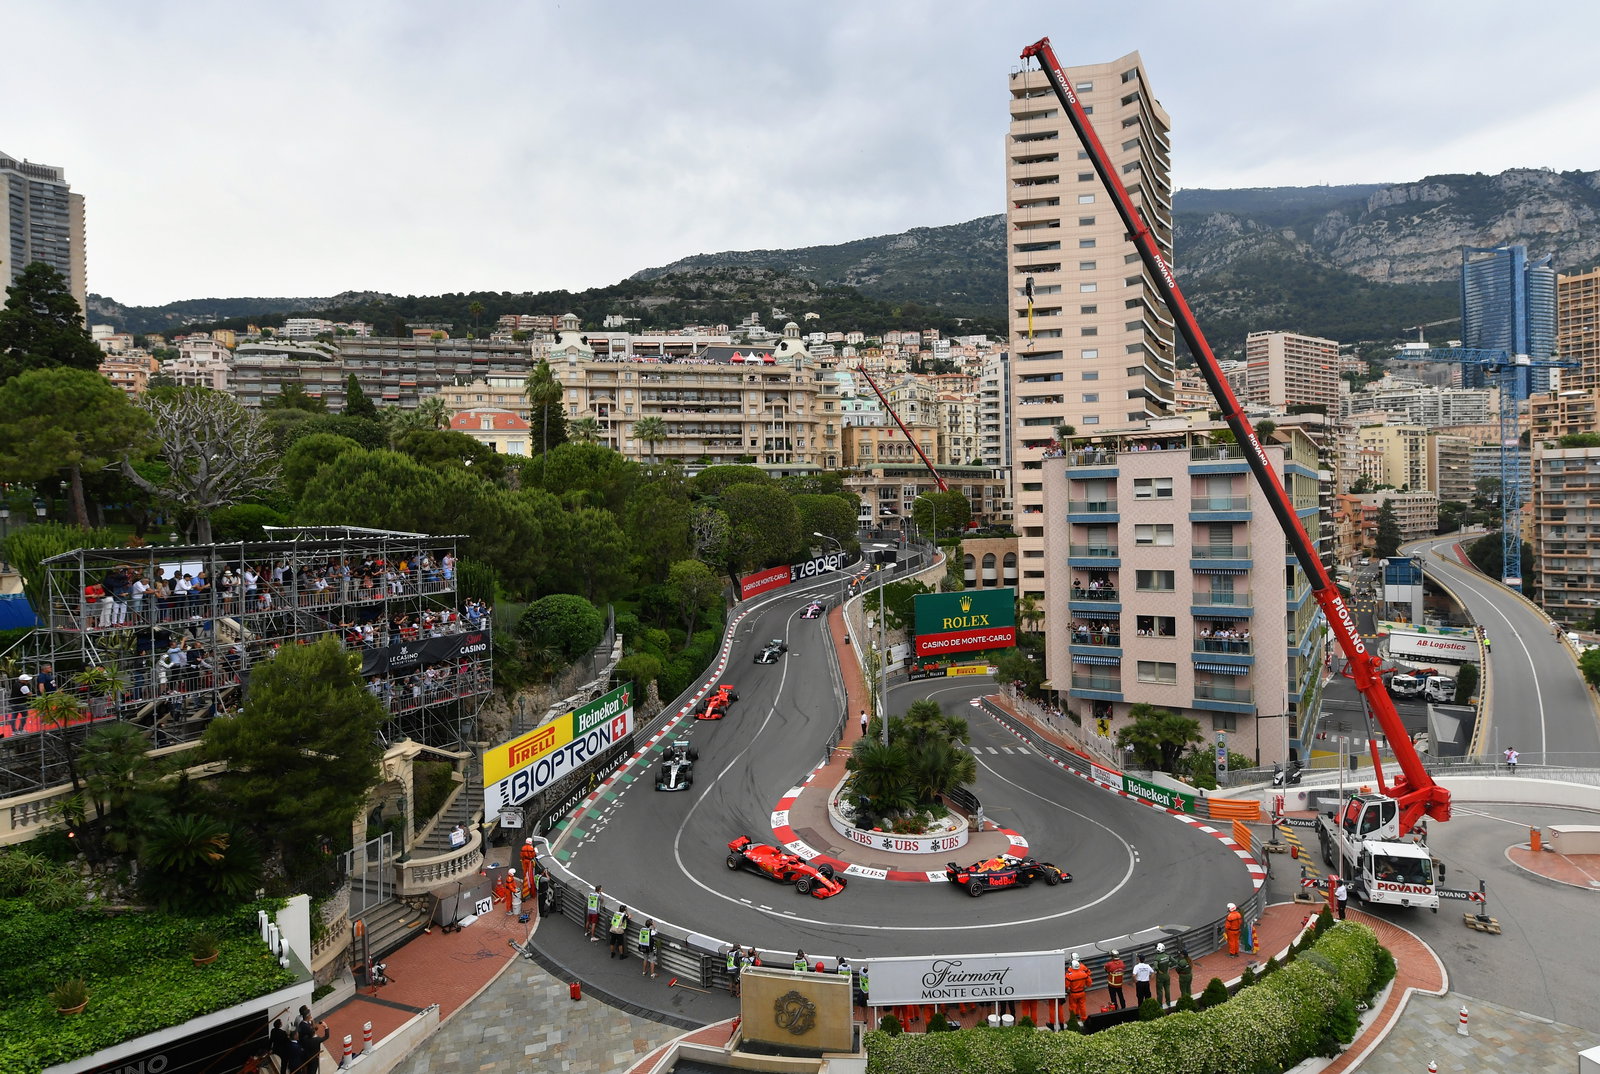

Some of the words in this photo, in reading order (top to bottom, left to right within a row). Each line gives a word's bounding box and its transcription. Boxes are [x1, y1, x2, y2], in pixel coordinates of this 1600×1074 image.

[1054, 68, 1076, 104] PIOVANO
[1153, 254, 1175, 289] PIOVANO
[1248, 433, 1268, 466] PIOVANO
[796, 552, 846, 578] zepter
[942, 614, 990, 629] ROLEX
[1332, 596, 1365, 654] PIOVANO
[460, 643, 487, 654] CASINO
[922, 639, 950, 649] CASINO
[950, 638, 961, 646] DE
[961, 633, 1012, 645] MONTE-CARLO
[1429, 641, 1466, 651] Logistics
[396, 652, 419, 662] CASINO
[578, 697, 620, 733] Heineken
[508, 726, 556, 769] PIRELLI
[511, 722, 612, 804] BIOPTRON
[547, 786, 587, 830] JOHNNIE
[596, 750, 628, 782] WALKER
[1127, 779, 1170, 806] Heineken
[852, 831, 872, 845] UBS
[895, 839, 919, 851] UBS
[941, 837, 959, 850] UBS
[798, 844, 817, 859] UBS
[861, 868, 885, 878] UBS
[989, 876, 1003, 886] Red
[1003, 874, 1017, 885] Bull
[1377, 882, 1432, 895] PIOVANO
[1436, 890, 1467, 898] IOVANO
[476, 899, 491, 915] FCY
[921, 959, 1013, 989] Fairmont
[921, 989, 967, 999] MONTE
[971, 985, 1015, 996] CARLO
